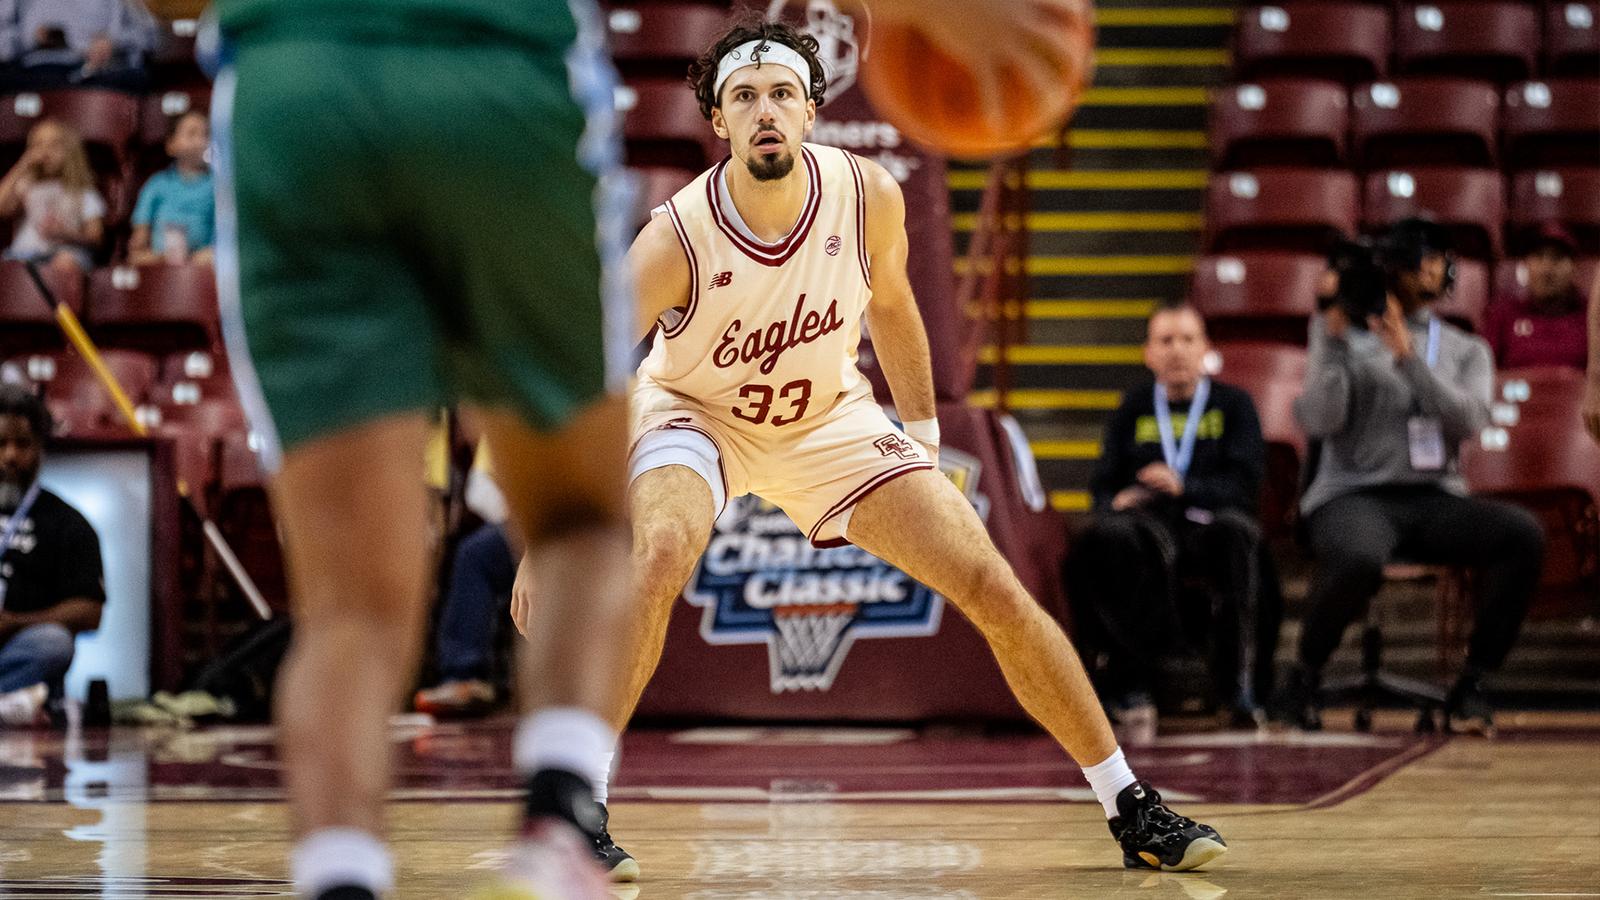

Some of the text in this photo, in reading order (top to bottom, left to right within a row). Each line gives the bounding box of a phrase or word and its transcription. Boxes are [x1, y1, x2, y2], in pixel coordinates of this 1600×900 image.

[713, 293, 844, 375] Eagles
[731, 378, 812, 427] 33
[743, 569, 908, 609] Classic
